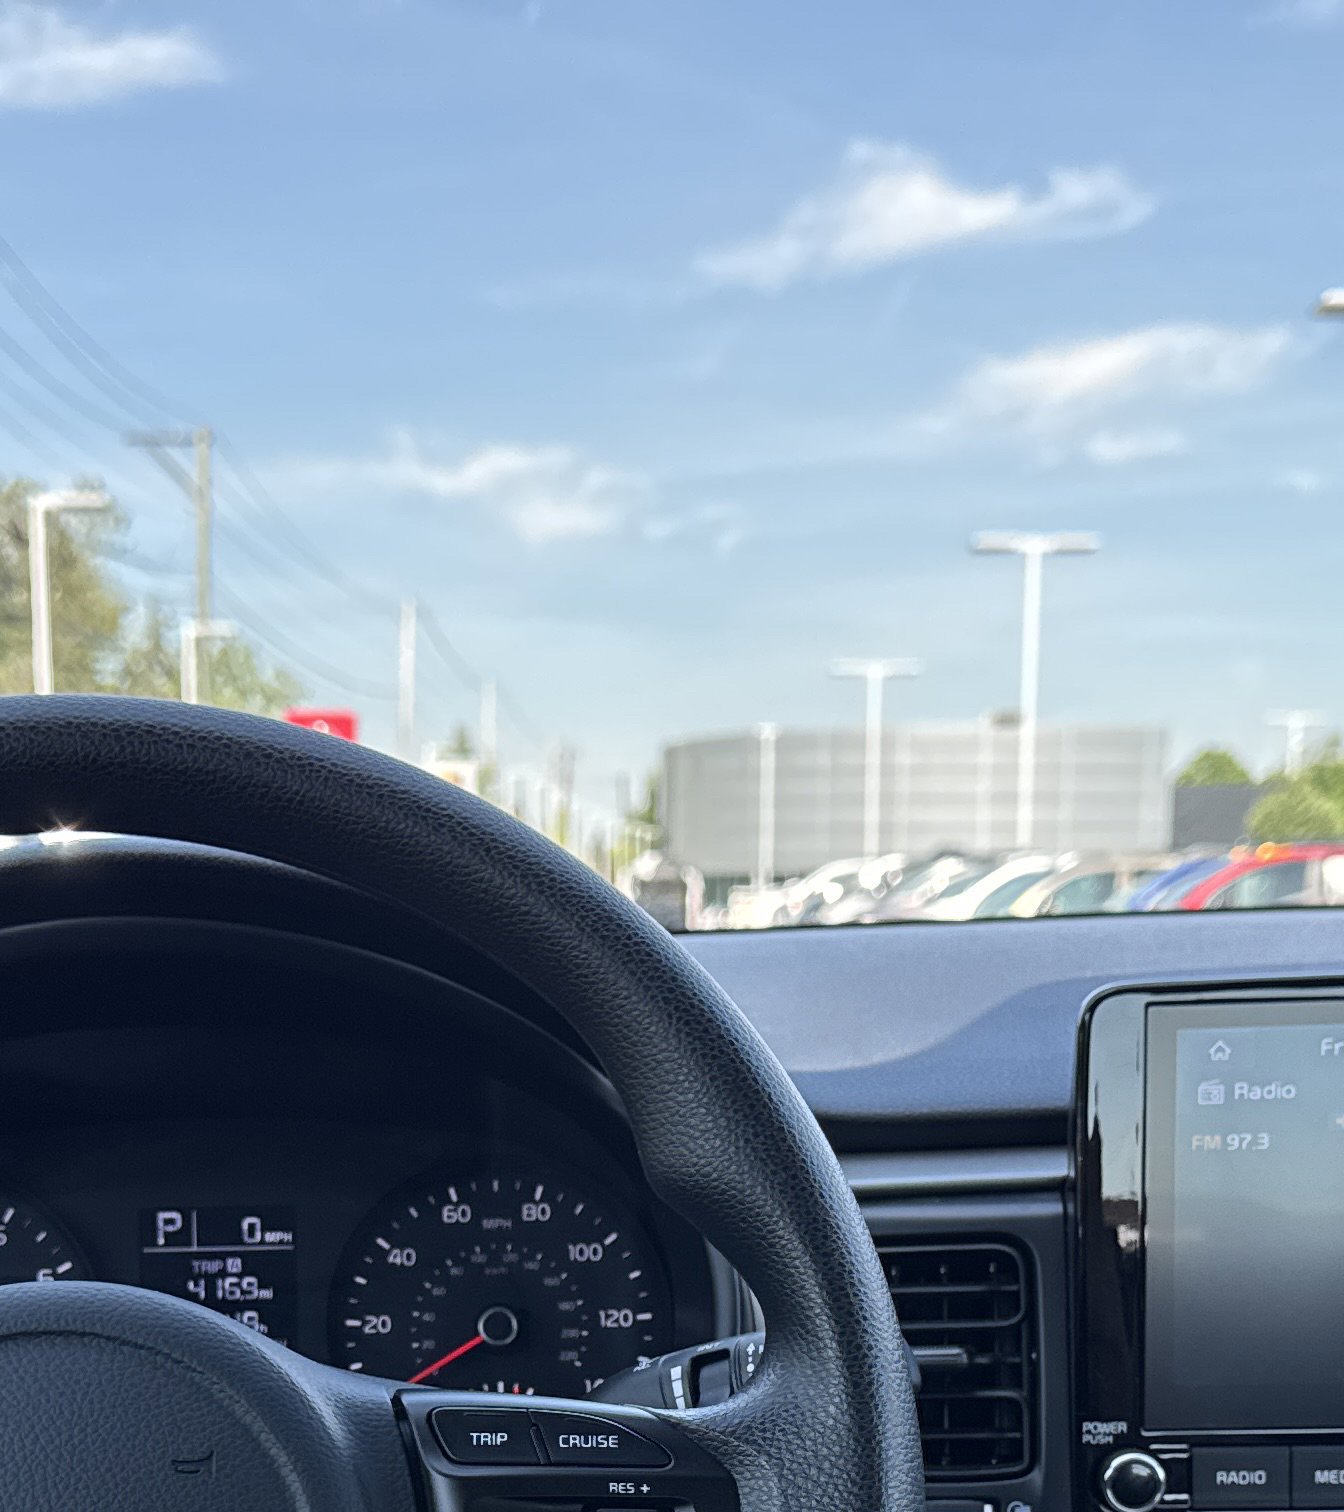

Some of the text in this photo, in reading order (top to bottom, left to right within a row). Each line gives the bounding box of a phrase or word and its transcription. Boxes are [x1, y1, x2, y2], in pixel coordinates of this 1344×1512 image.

[1234, 1082, 1296, 1100] Radio
[1192, 1132, 1270, 1152] FM 97.3
[442, 1203, 471, 1224] 60
[521, 1202, 551, 1222] 80
[157, 1211, 182, 1245] P
[241, 1217, 261, 1244] 0
[387, 1248, 416, 1267] 40
[568, 1243, 603, 1262] 100
[363, 1315, 392, 1334] 20
[599, 1309, 633, 1328] 120
[1082, 1421, 1127, 1435] POWER
[469, 1432, 508, 1445] TRIP
[558, 1434, 620, 1448] CRUISE
[1082, 1434, 1113, 1445] PUSH
[1216, 1470, 1267, 1486] RADIO
[609, 1482, 635, 1494] RES
